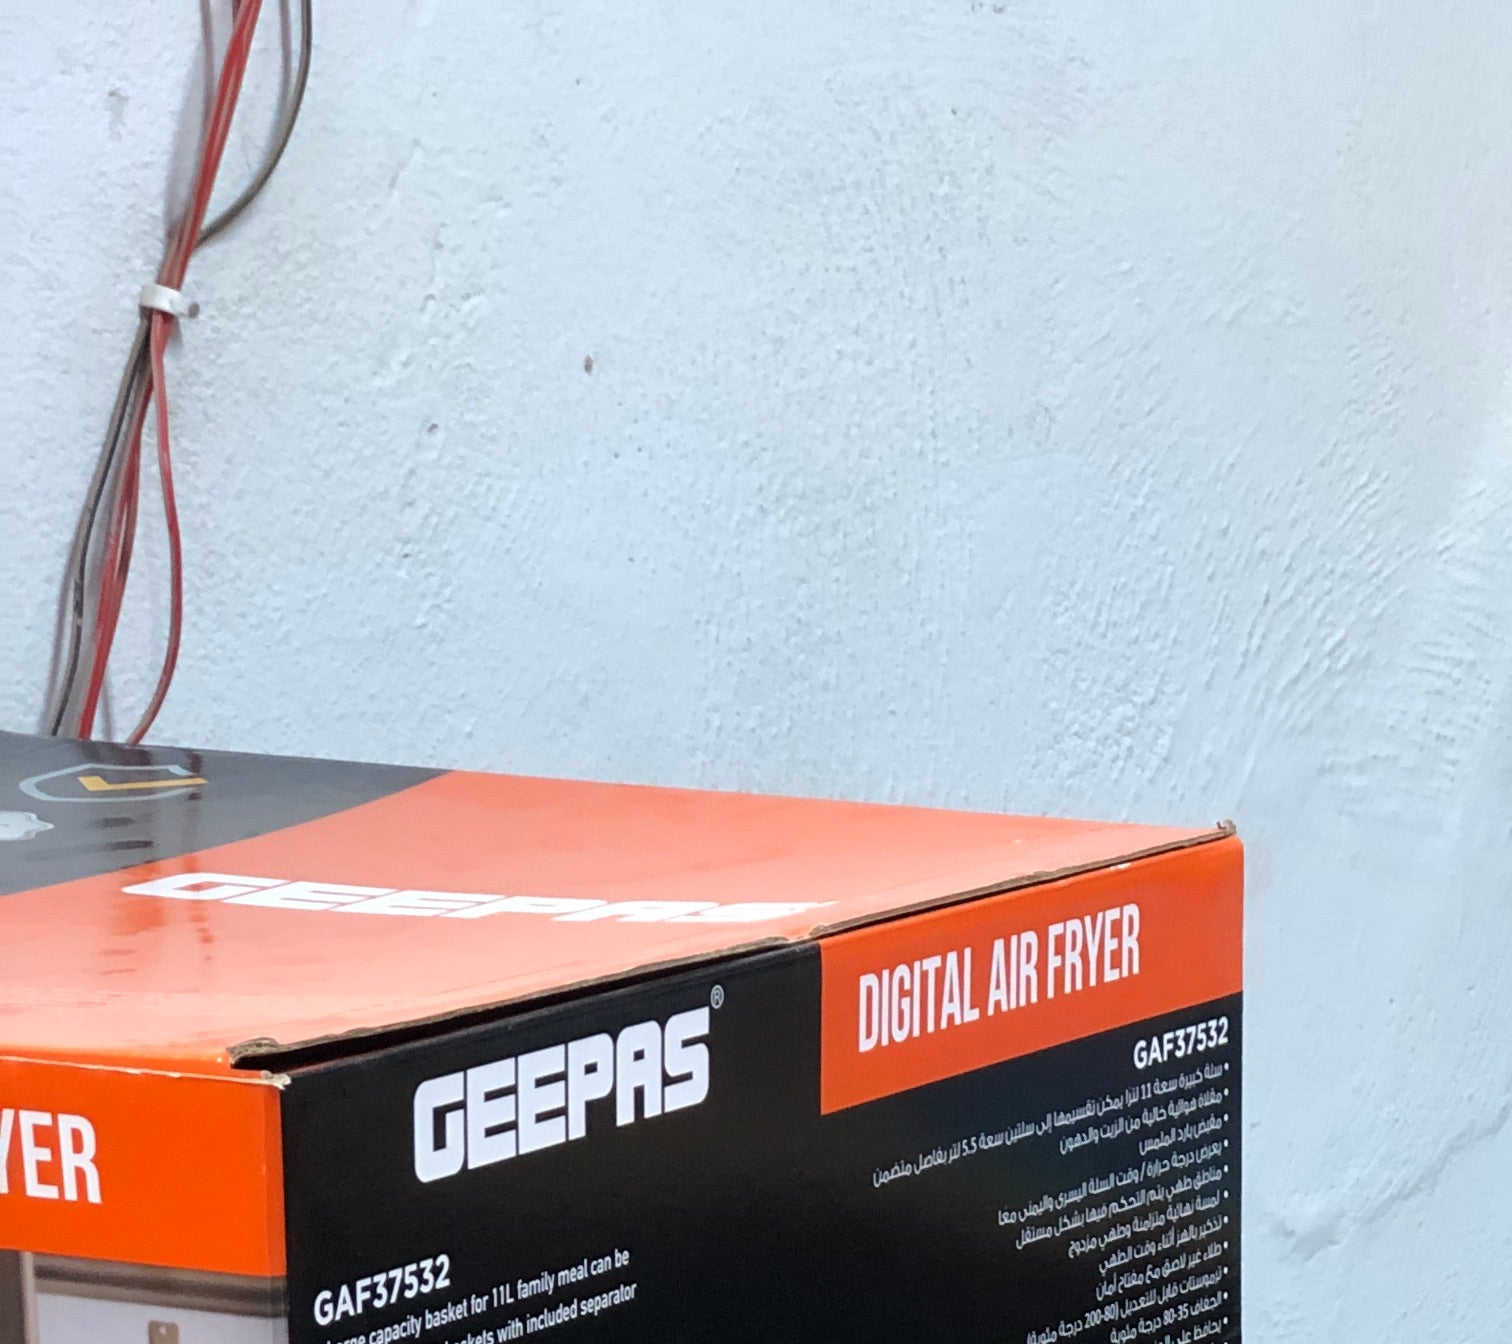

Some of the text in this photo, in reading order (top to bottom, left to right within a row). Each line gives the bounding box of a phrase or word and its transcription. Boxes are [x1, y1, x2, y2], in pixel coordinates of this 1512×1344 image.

[122, 872, 840, 923] GEEPAS
[858, 903, 1141, 1053] DIGITAL AIR FRYER
[1134, 1016, 1229, 1069] GAF37532
[413, 1006, 710, 1183] GEEPAS
[313, 1255, 451, 1326] GAF37532
[424, 1298, 469, 1330] basket
[470, 1294, 490, 1315] for
[492, 1283, 515, 1308] 11L
[516, 1270, 556, 1300] family
[557, 1258, 589, 1287] meal
[590, 1255, 612, 1276] can
[614, 1248, 630, 1268] be
[496, 1317, 524, 1344] with
[526, 1298, 578, 1334] included
[579, 1283, 638, 1317] separator
